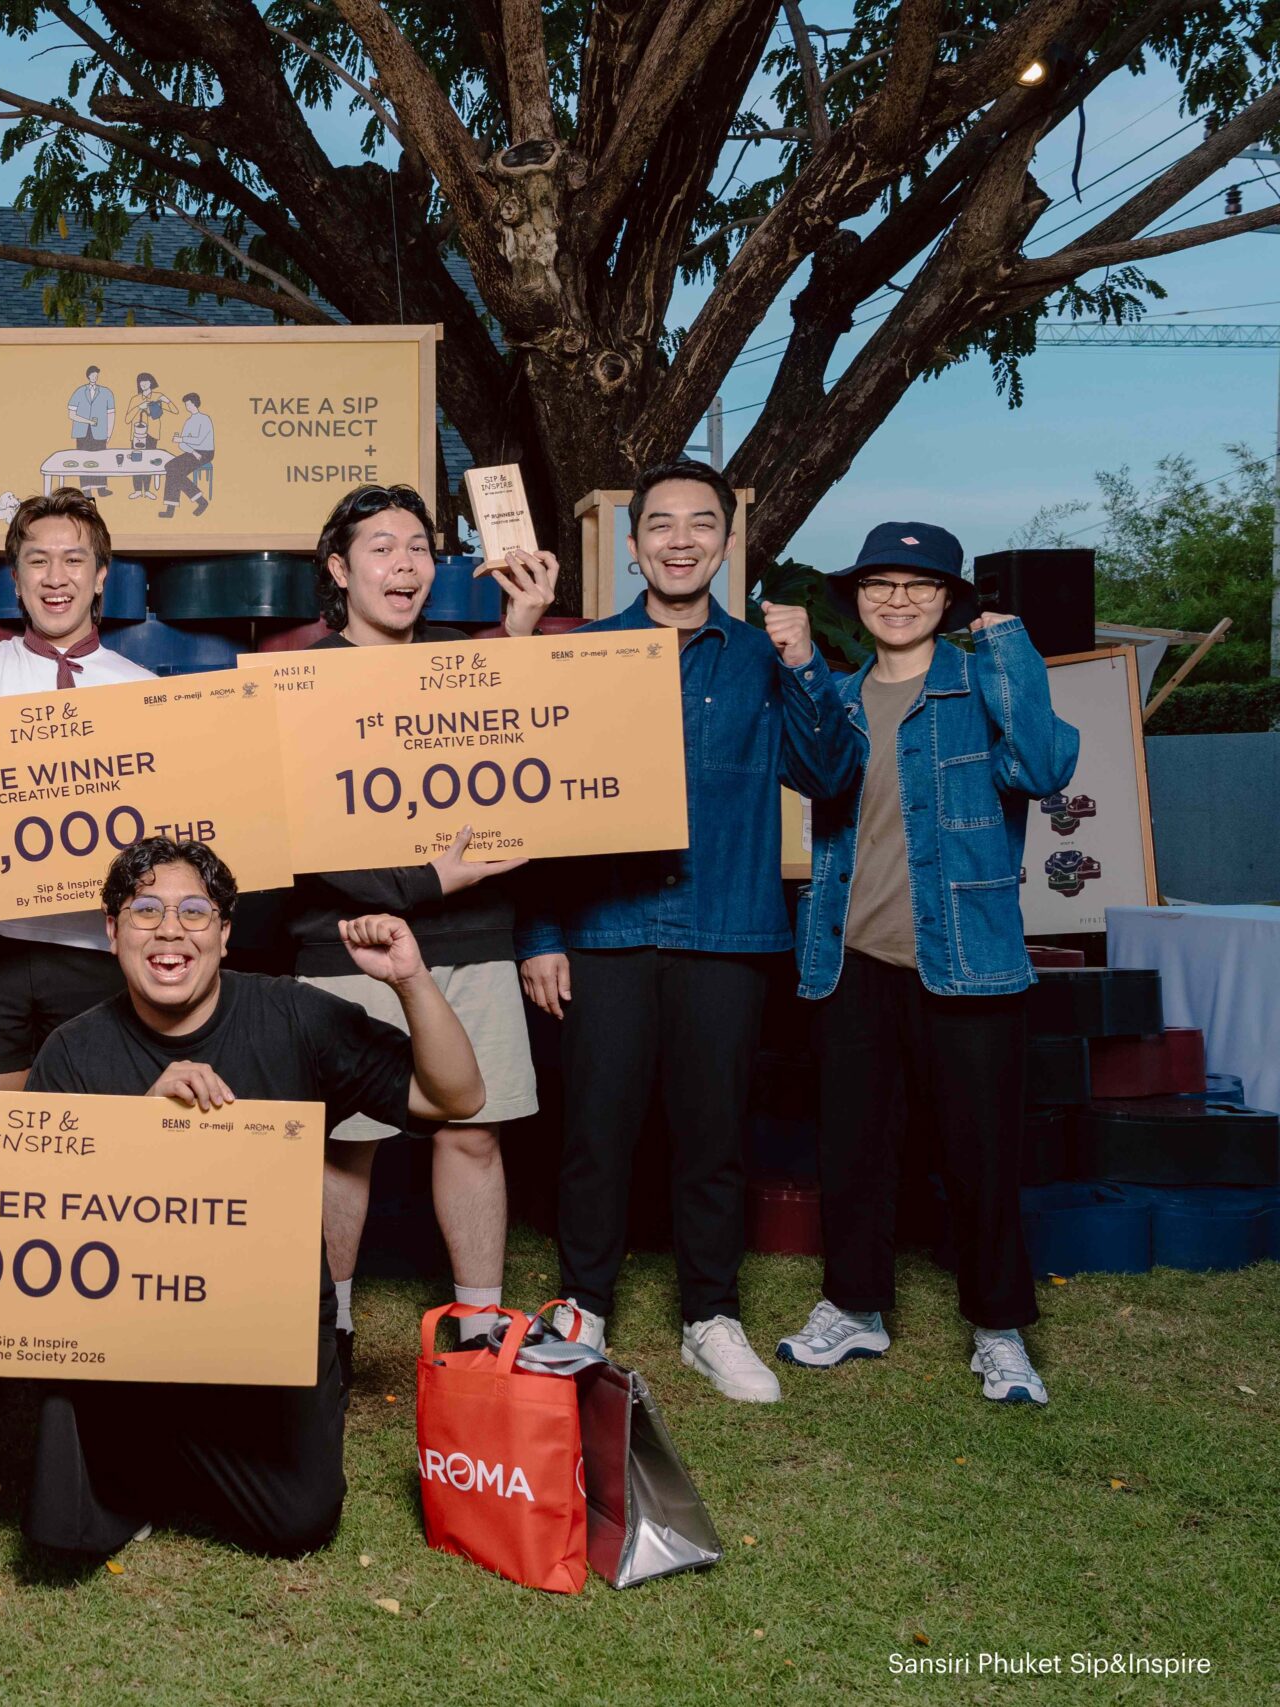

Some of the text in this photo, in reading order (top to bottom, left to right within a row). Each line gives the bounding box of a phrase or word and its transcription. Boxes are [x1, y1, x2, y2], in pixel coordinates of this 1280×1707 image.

[249, 397, 378, 414] TAKE A SIP
[262, 420, 377, 437] CONNECT
[287, 465, 377, 482] INSPIRE
[484, 475, 498, 483] SIP
[551, 650, 574, 660] BEANS
[580, 650, 608, 658] CP-meiji
[616, 647, 640, 655] AROMA
[431, 653, 486, 671] SIP &
[420, 672, 501, 690] INSPIRE
[144, 694, 168, 705] BEANS
[174, 691, 203, 701] CP-meiji
[210, 688, 236, 697] AROMA
[21, 703, 77, 723] SIP &
[356, 706, 569, 739] 1st RUNNER UP
[10, 720, 95, 744] INSPIRE
[403, 733, 524, 750] CREATIVE DRINK
[27, 752, 156, 787] WINNER
[75, 780, 120, 795] DRINK
[336, 758, 619, 819] 10,000 THB
[154, 820, 216, 846] THB
[436, 832, 453, 842] Sip
[415, 844, 428, 854] By
[431, 843, 451, 852] The
[497, 838, 524, 848] 2026
[37, 878, 103, 894] Sip & Inspire
[16, 897, 30, 907] By
[33, 895, 53, 904] The
[56, 889, 96, 902] Society
[8, 1110, 78, 1131] SIP &
[162, 1118, 191, 1129] BEANS
[199, 1122, 234, 1132] CP-meiji
[244, 1123, 275, 1132] AROMA
[62, 1194, 247, 1225] FAVORITE
[132, 1274, 206, 1302] THB
[20, 1337, 28, 1346] &
[33, 1335, 78, 1351] Inspire
[17, 1350, 66, 1364] Society
[71, 1352, 105, 1363] 2026
